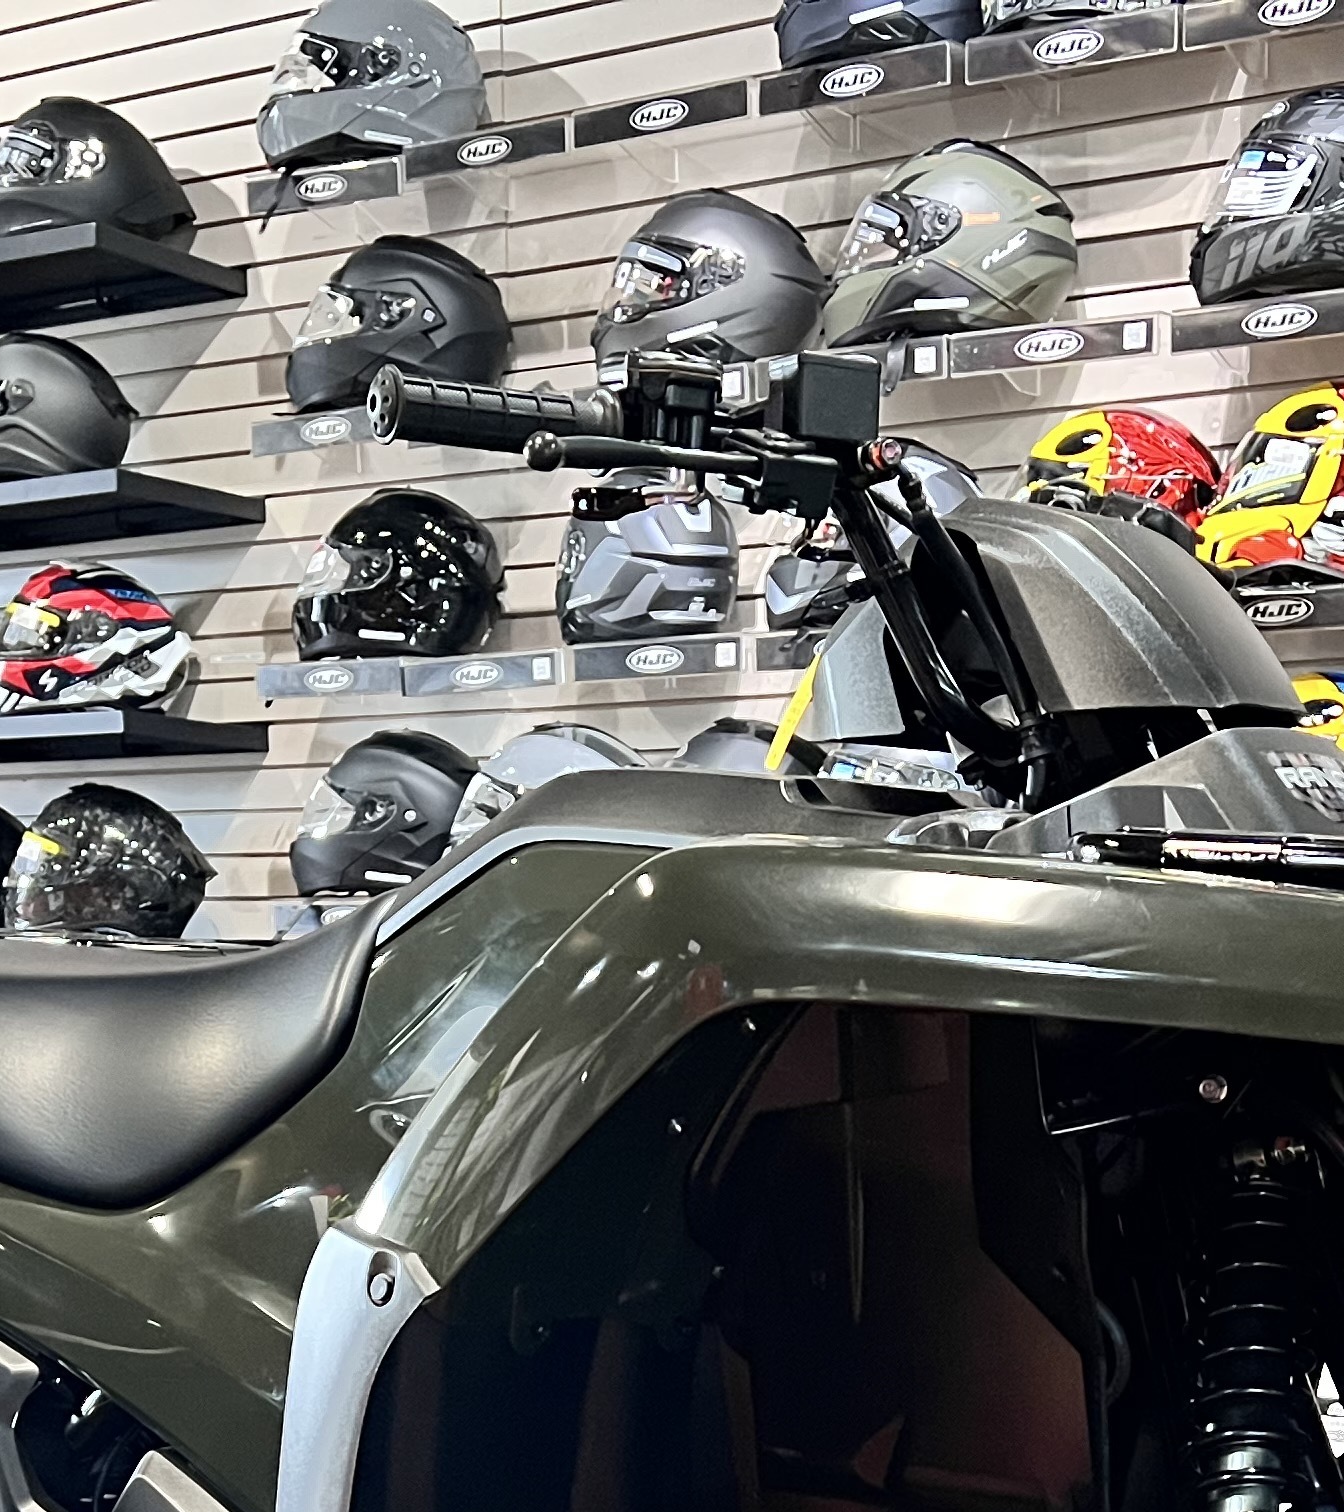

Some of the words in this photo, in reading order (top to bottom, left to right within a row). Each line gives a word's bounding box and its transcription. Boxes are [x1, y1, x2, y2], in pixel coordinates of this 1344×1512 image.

[1269, 0, 1329, 19] HJC
[1042, 35, 1096, 56] HJC
[829, 69, 875, 91] HJC
[639, 107, 680, 124] HJC
[467, 141, 505, 158] HJC
[304, 179, 339, 195] HJC
[981, 230, 1029, 270] HJC
[1253, 312, 1306, 332] HJC
[1023, 333, 1076, 355] HJC
[307, 420, 347, 438] HJC
[1252, 602, 1302, 619] HJC
[634, 652, 676, 669] HJC
[309, 671, 349, 688] HJC
[457, 666, 498, 683] HJC
